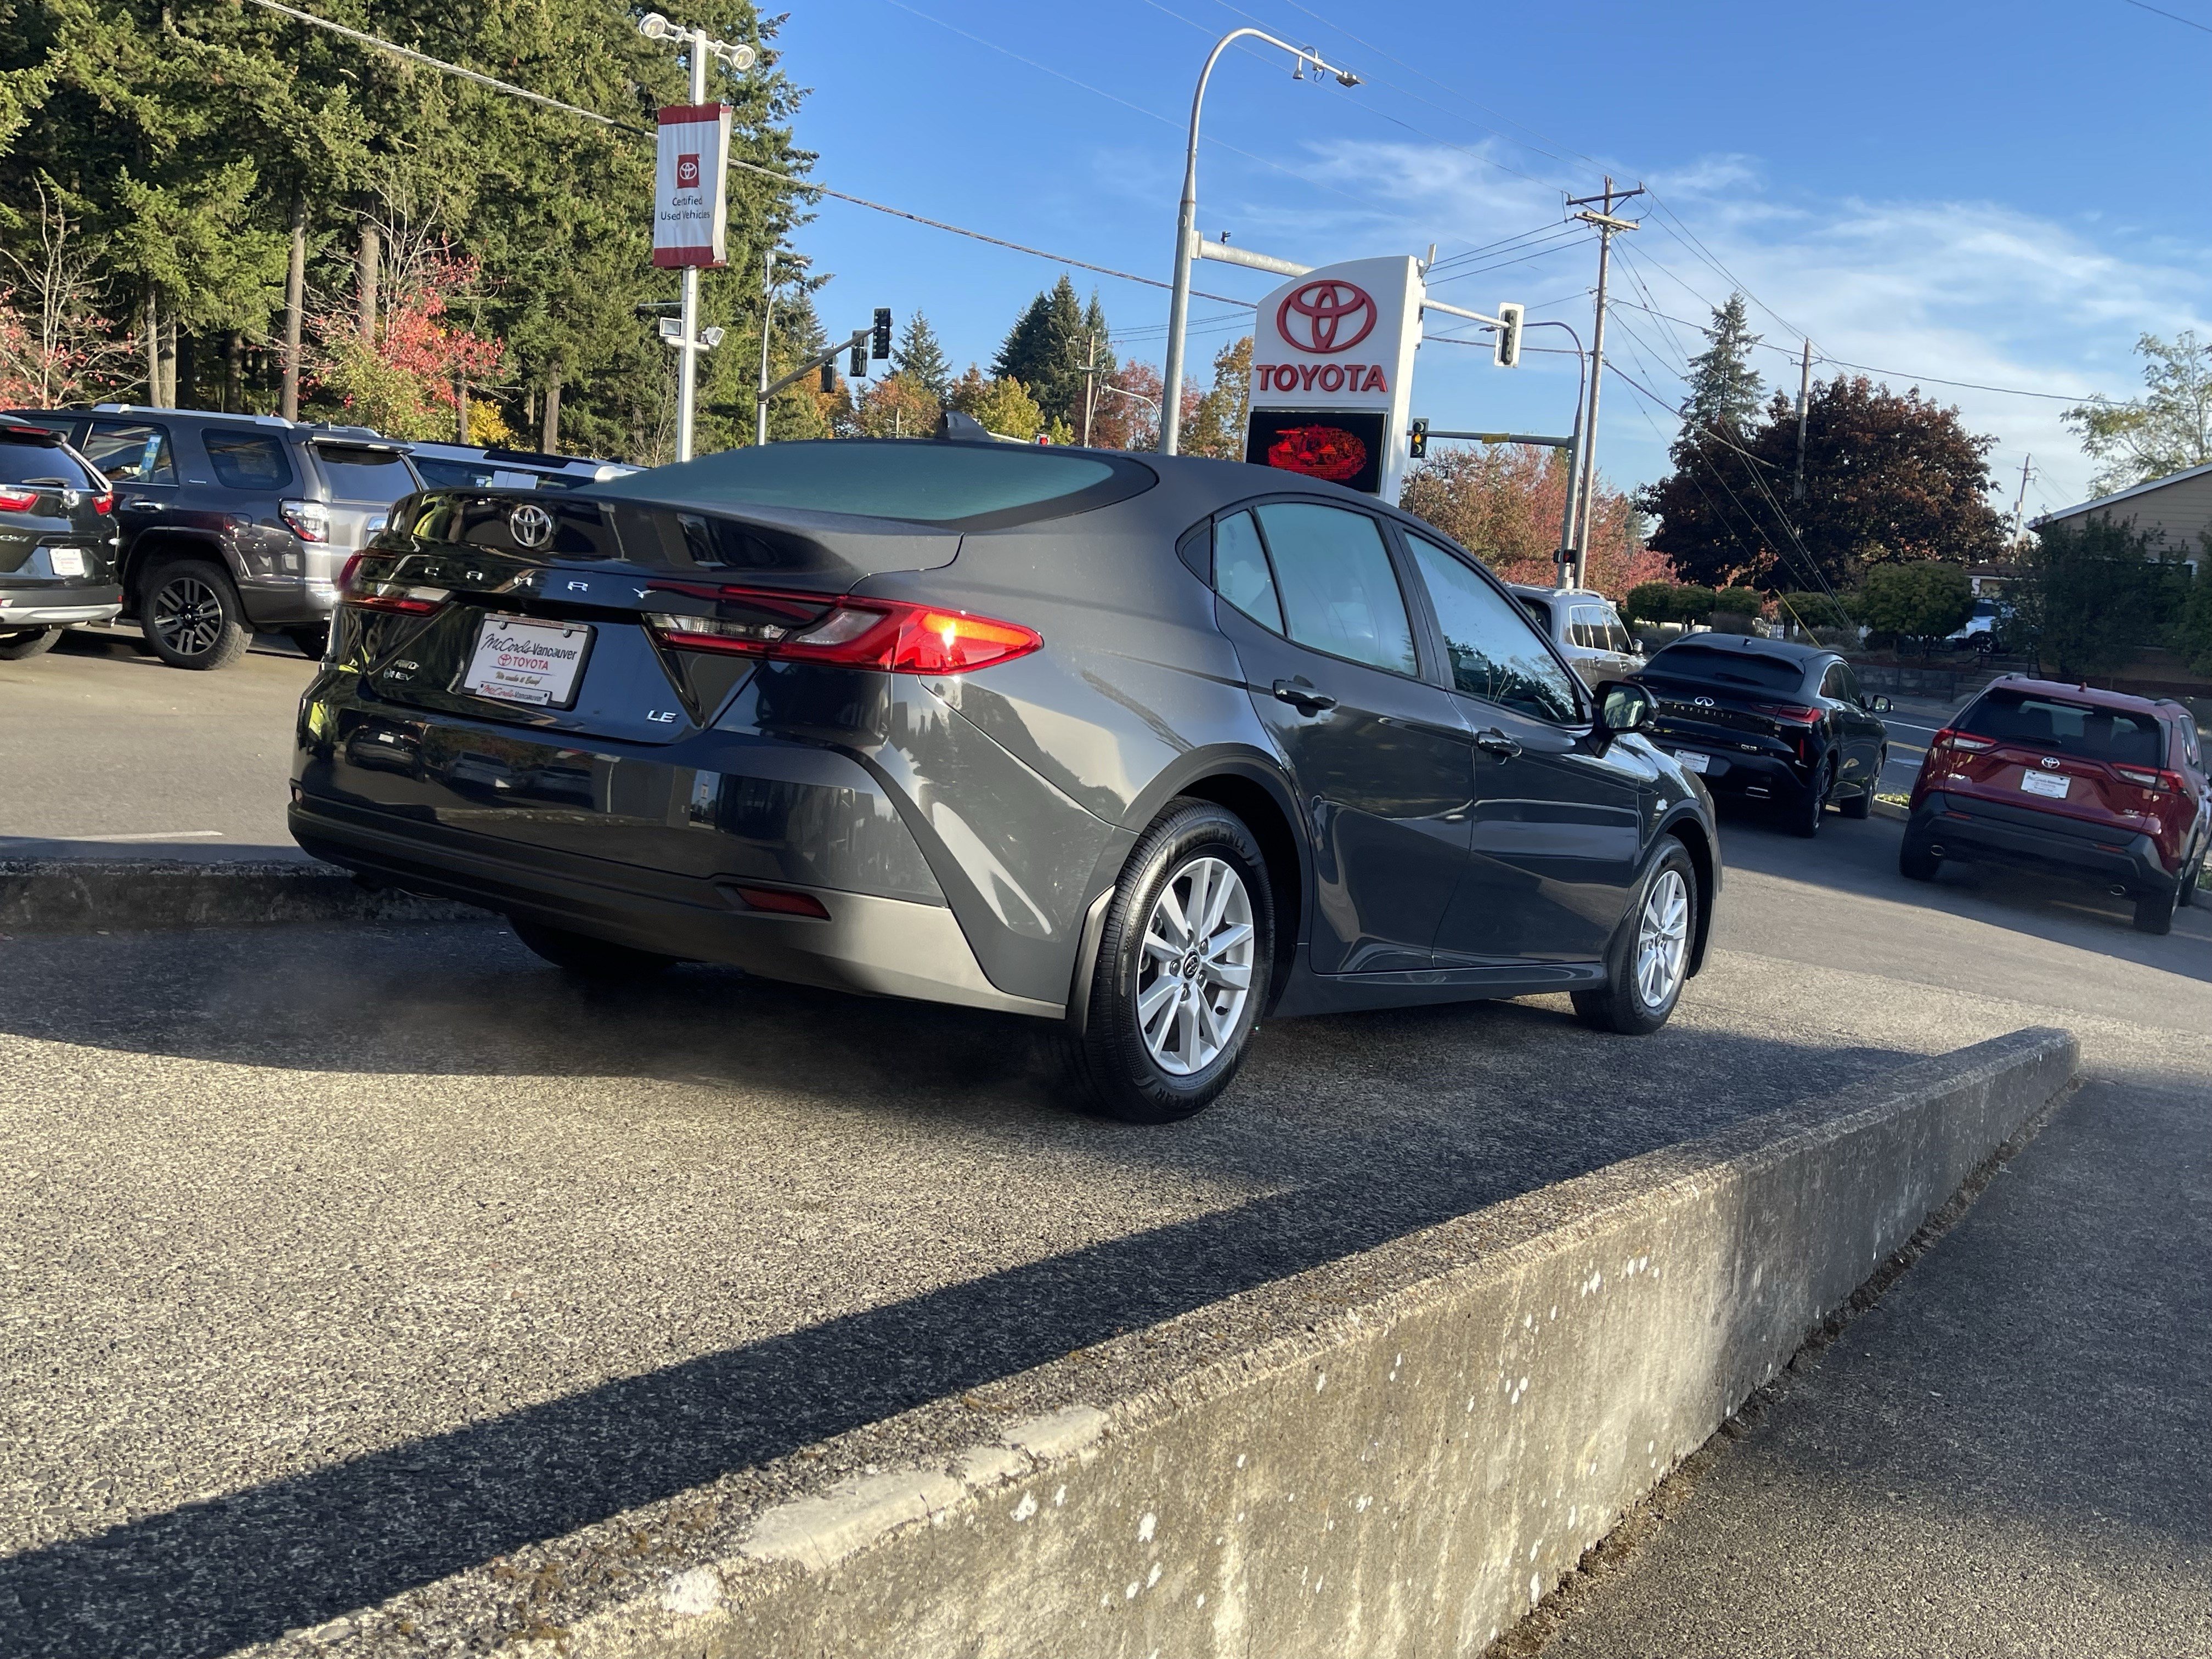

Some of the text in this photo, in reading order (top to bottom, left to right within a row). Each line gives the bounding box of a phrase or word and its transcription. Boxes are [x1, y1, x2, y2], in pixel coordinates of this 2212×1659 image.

[672, 195, 703, 206] Certified
[661, 209, 710, 221] Used Vehicles
[1256, 364, 1389, 392] TOYOTA
[532, 642, 577, 661] Vancouver
[513, 656, 549, 670] TOYOTA
[646, 710, 676, 723] LE
